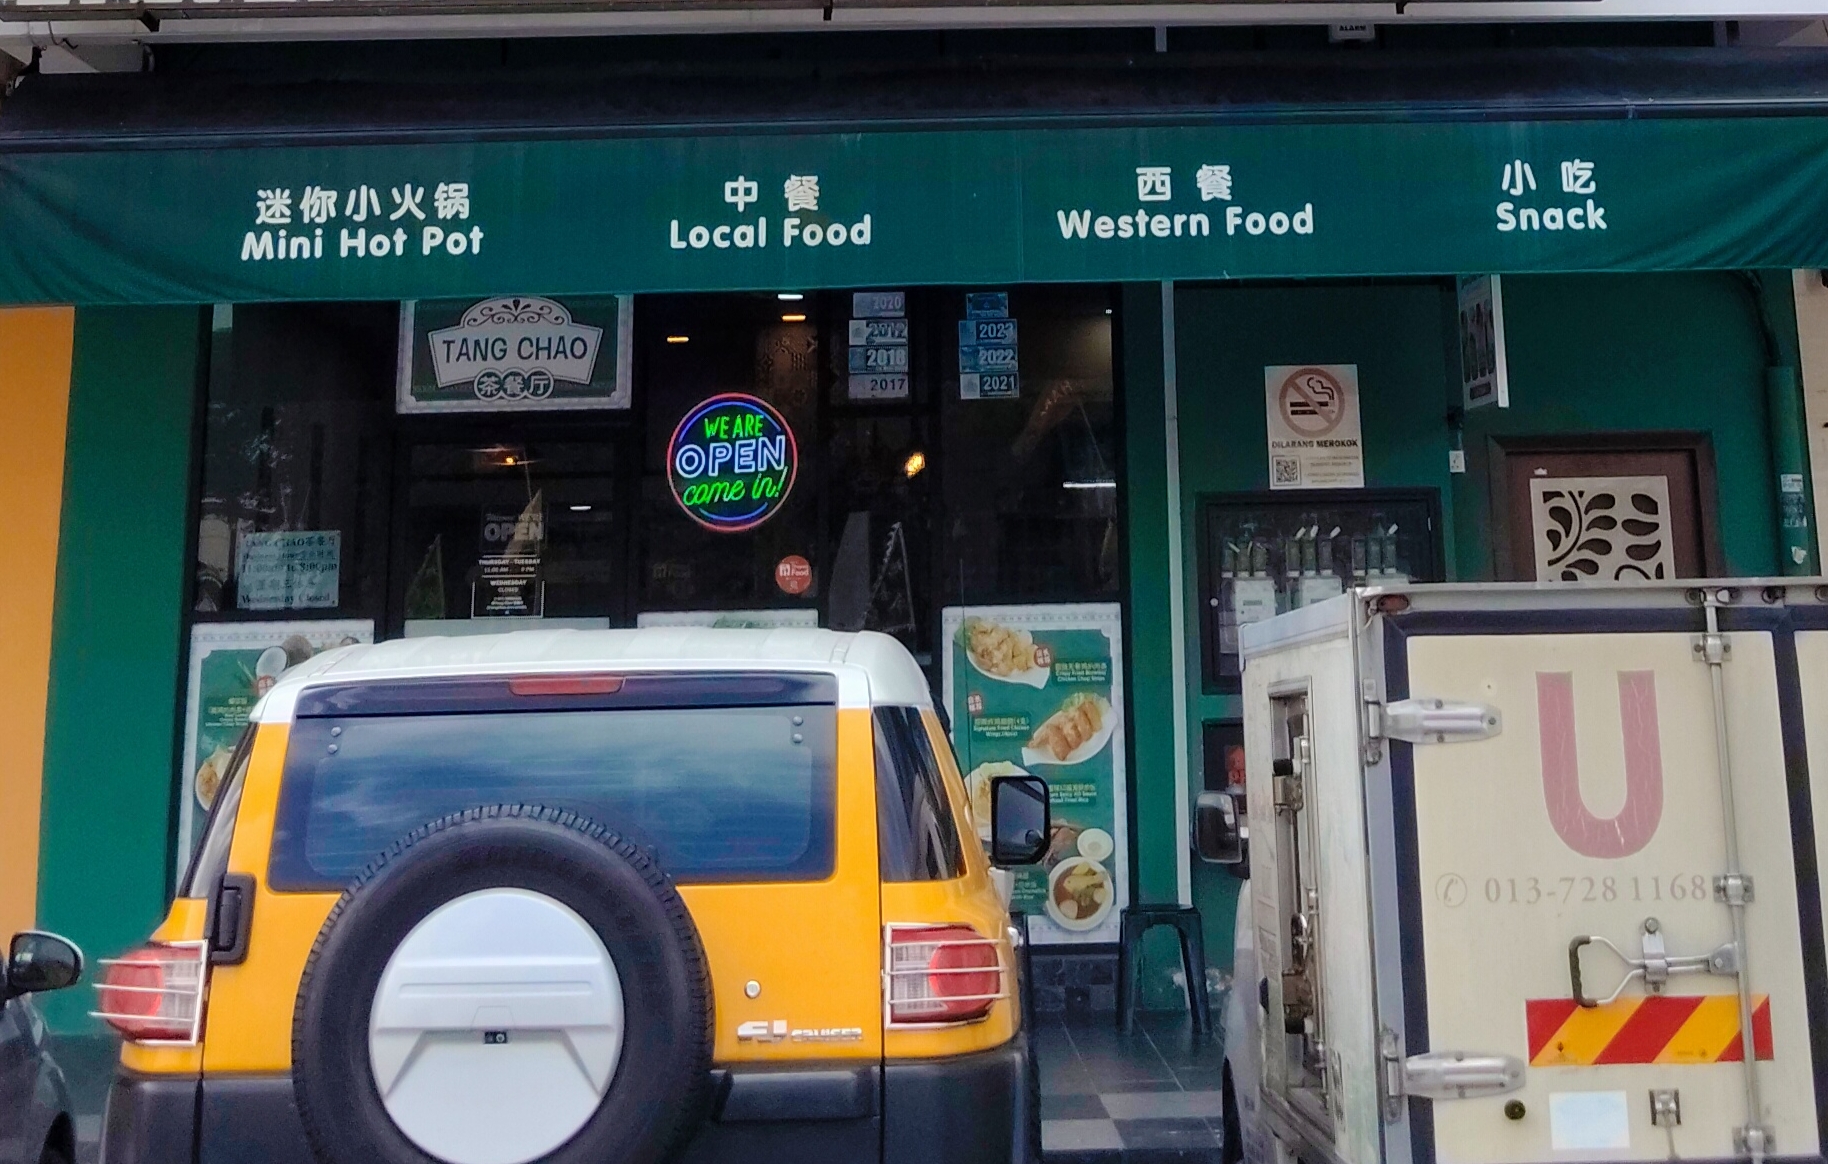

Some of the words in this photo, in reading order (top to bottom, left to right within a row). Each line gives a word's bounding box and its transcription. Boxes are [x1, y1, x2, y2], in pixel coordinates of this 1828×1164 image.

[724, 174, 820, 212] 中餐
[1136, 165, 1233, 202] 西餐
[1501, 158, 1595, 196] 小吃
[255, 182, 470, 225] 迷你小火锅
[1057, 209, 1210, 240] Western
[1226, 203, 1314, 236] Food
[1497, 199, 1608, 232] Snack
[240, 228, 323, 261] Mini
[340, 227, 407, 259] Hot
[422, 225, 483, 256] Pot
[669, 216, 767, 250] Local
[783, 214, 872, 247] Food
[442, 337, 508, 363] TANG
[517, 335, 588, 360] CHAO
[479, 375, 551, 396] 茶餐厅
[870, 379, 906, 391] 2017
[983, 376, 1015, 391] 2021
[704, 417, 730, 439] WE
[732, 414, 764, 438] ARE
[1272, 440, 1314, 449] DILARANG
[676, 435, 786, 478] OPEN
[683, 480, 746, 505] come
[752, 466, 788, 499] in!
[484, 522, 545, 542] OPEN
[1535, 670, 1664, 859] U
[1484, 877, 1618, 904] 013-728
[1631, 874, 1707, 902] 1168
